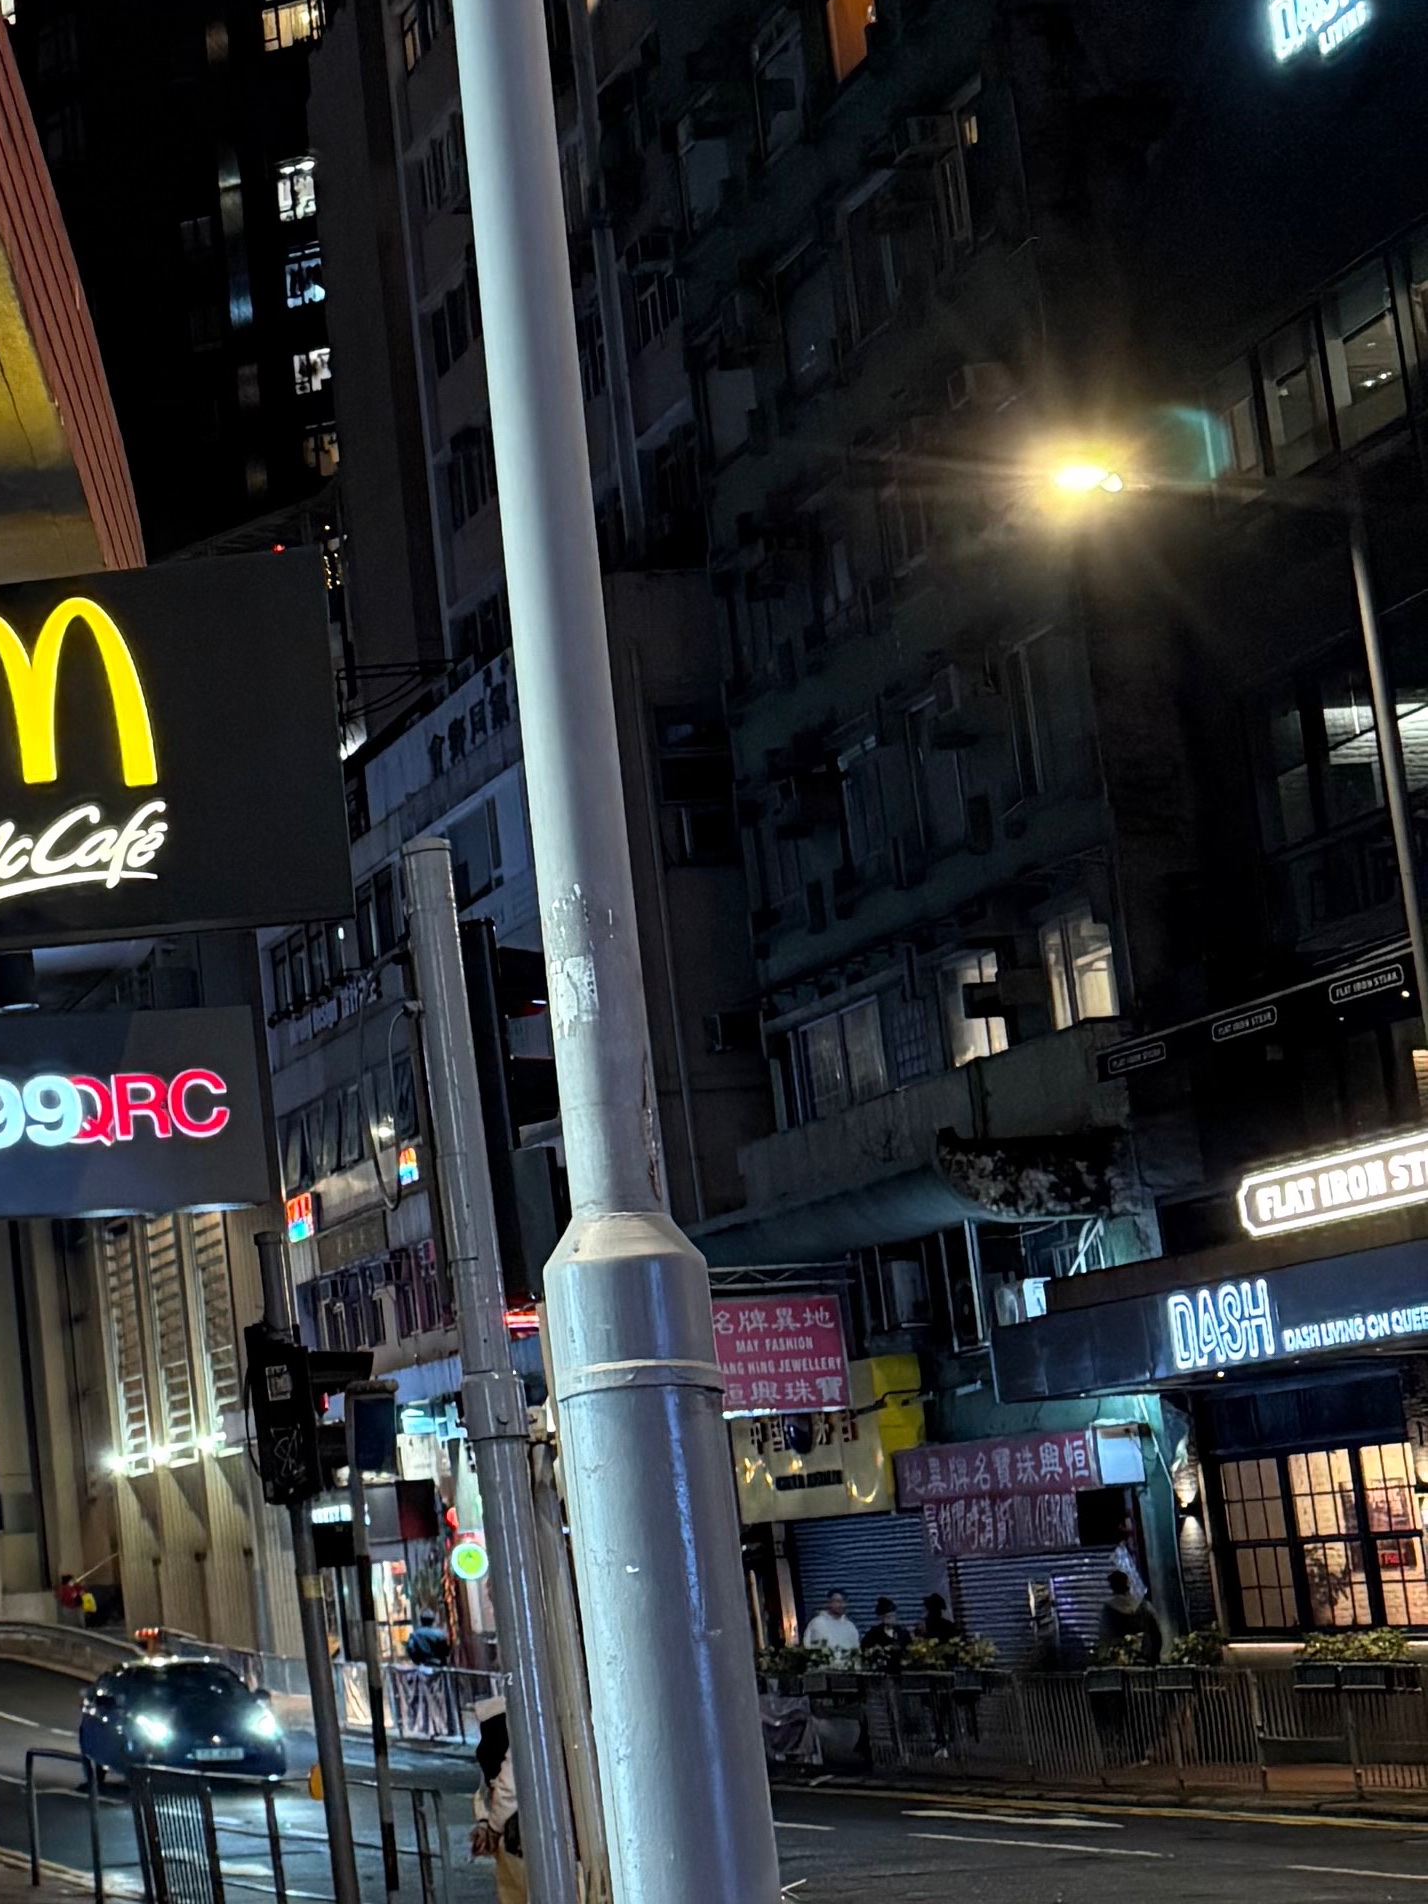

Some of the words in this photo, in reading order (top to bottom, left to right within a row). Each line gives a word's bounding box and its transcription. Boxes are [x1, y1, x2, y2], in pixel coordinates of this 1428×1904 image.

[1255, 1177, 1316, 1222] FLAT
[1318, 1159, 1387, 1208] IRON
[1167, 1279, 1275, 1370] DASH
[1282, 1326, 1321, 1352] DASH
[1322, 1317, 1365, 1347] LIVING
[1366, 1313, 1391, 1339] ON
[735, 1338, 759, 1353] MAY
[765, 1336, 813, 1352] FASHION
[718, 1362, 744, 1376] ANG
[778, 1356, 842, 1373] JEWELLERY
